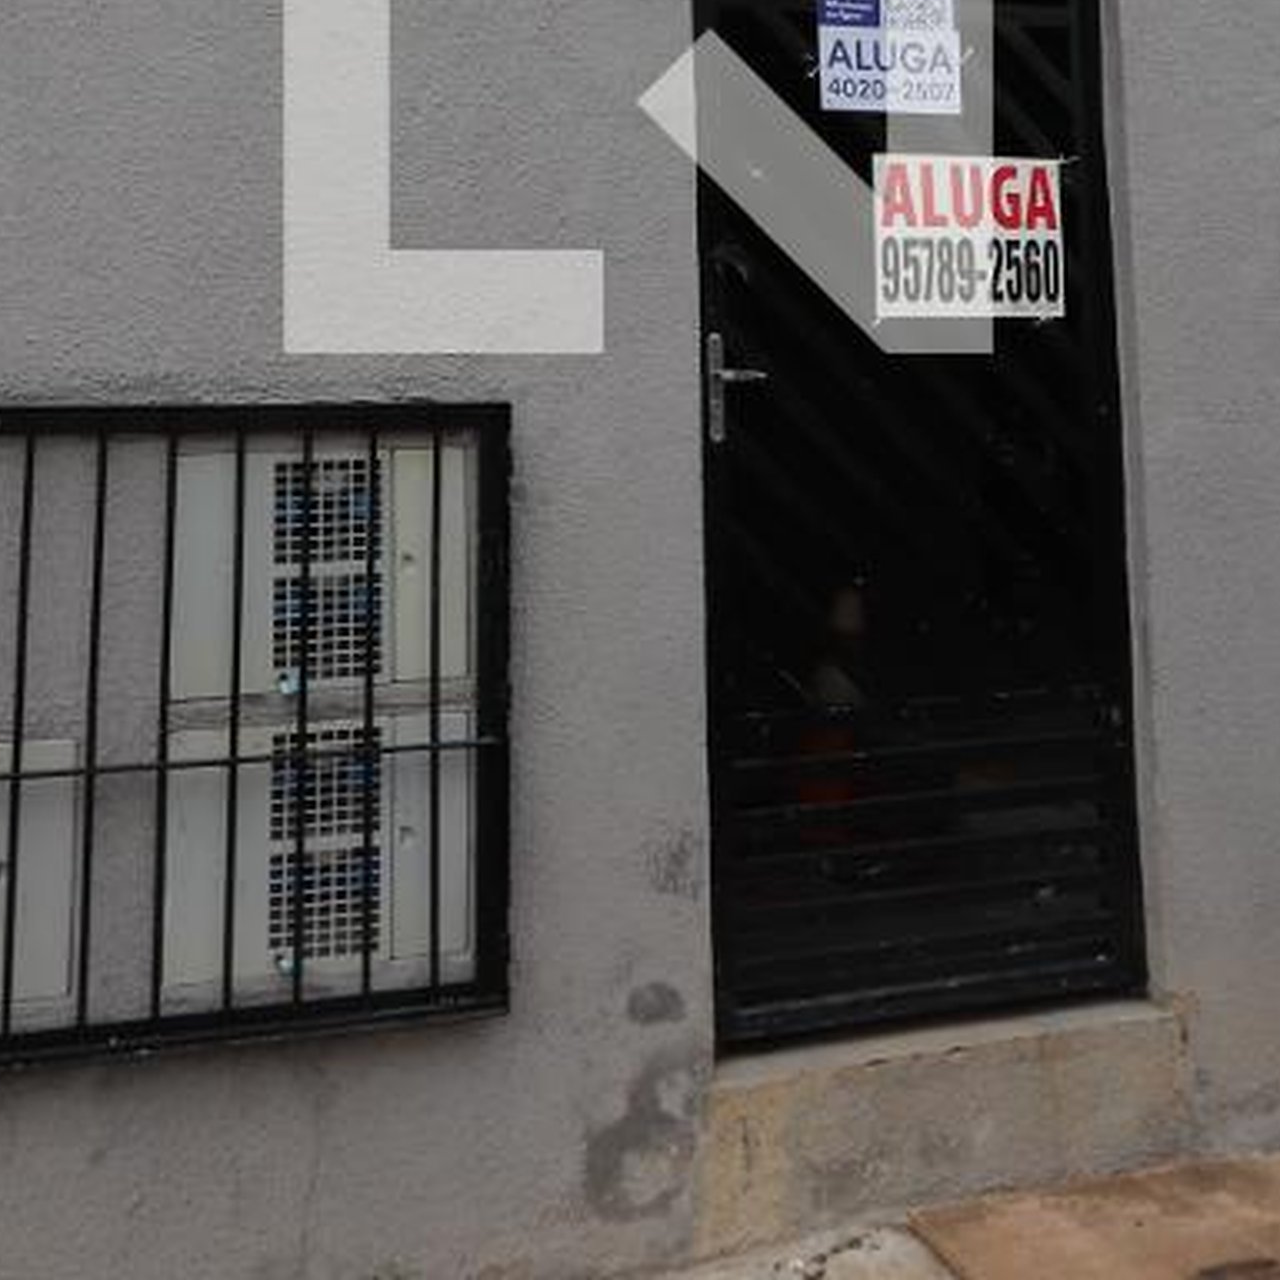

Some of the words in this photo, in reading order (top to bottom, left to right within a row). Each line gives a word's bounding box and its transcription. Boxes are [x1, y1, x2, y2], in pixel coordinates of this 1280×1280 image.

[827, 39, 953, 74] ALUGA
[880, 162, 1058, 231] ALUGA
[880, 236, 1060, 304] 95789-2560
